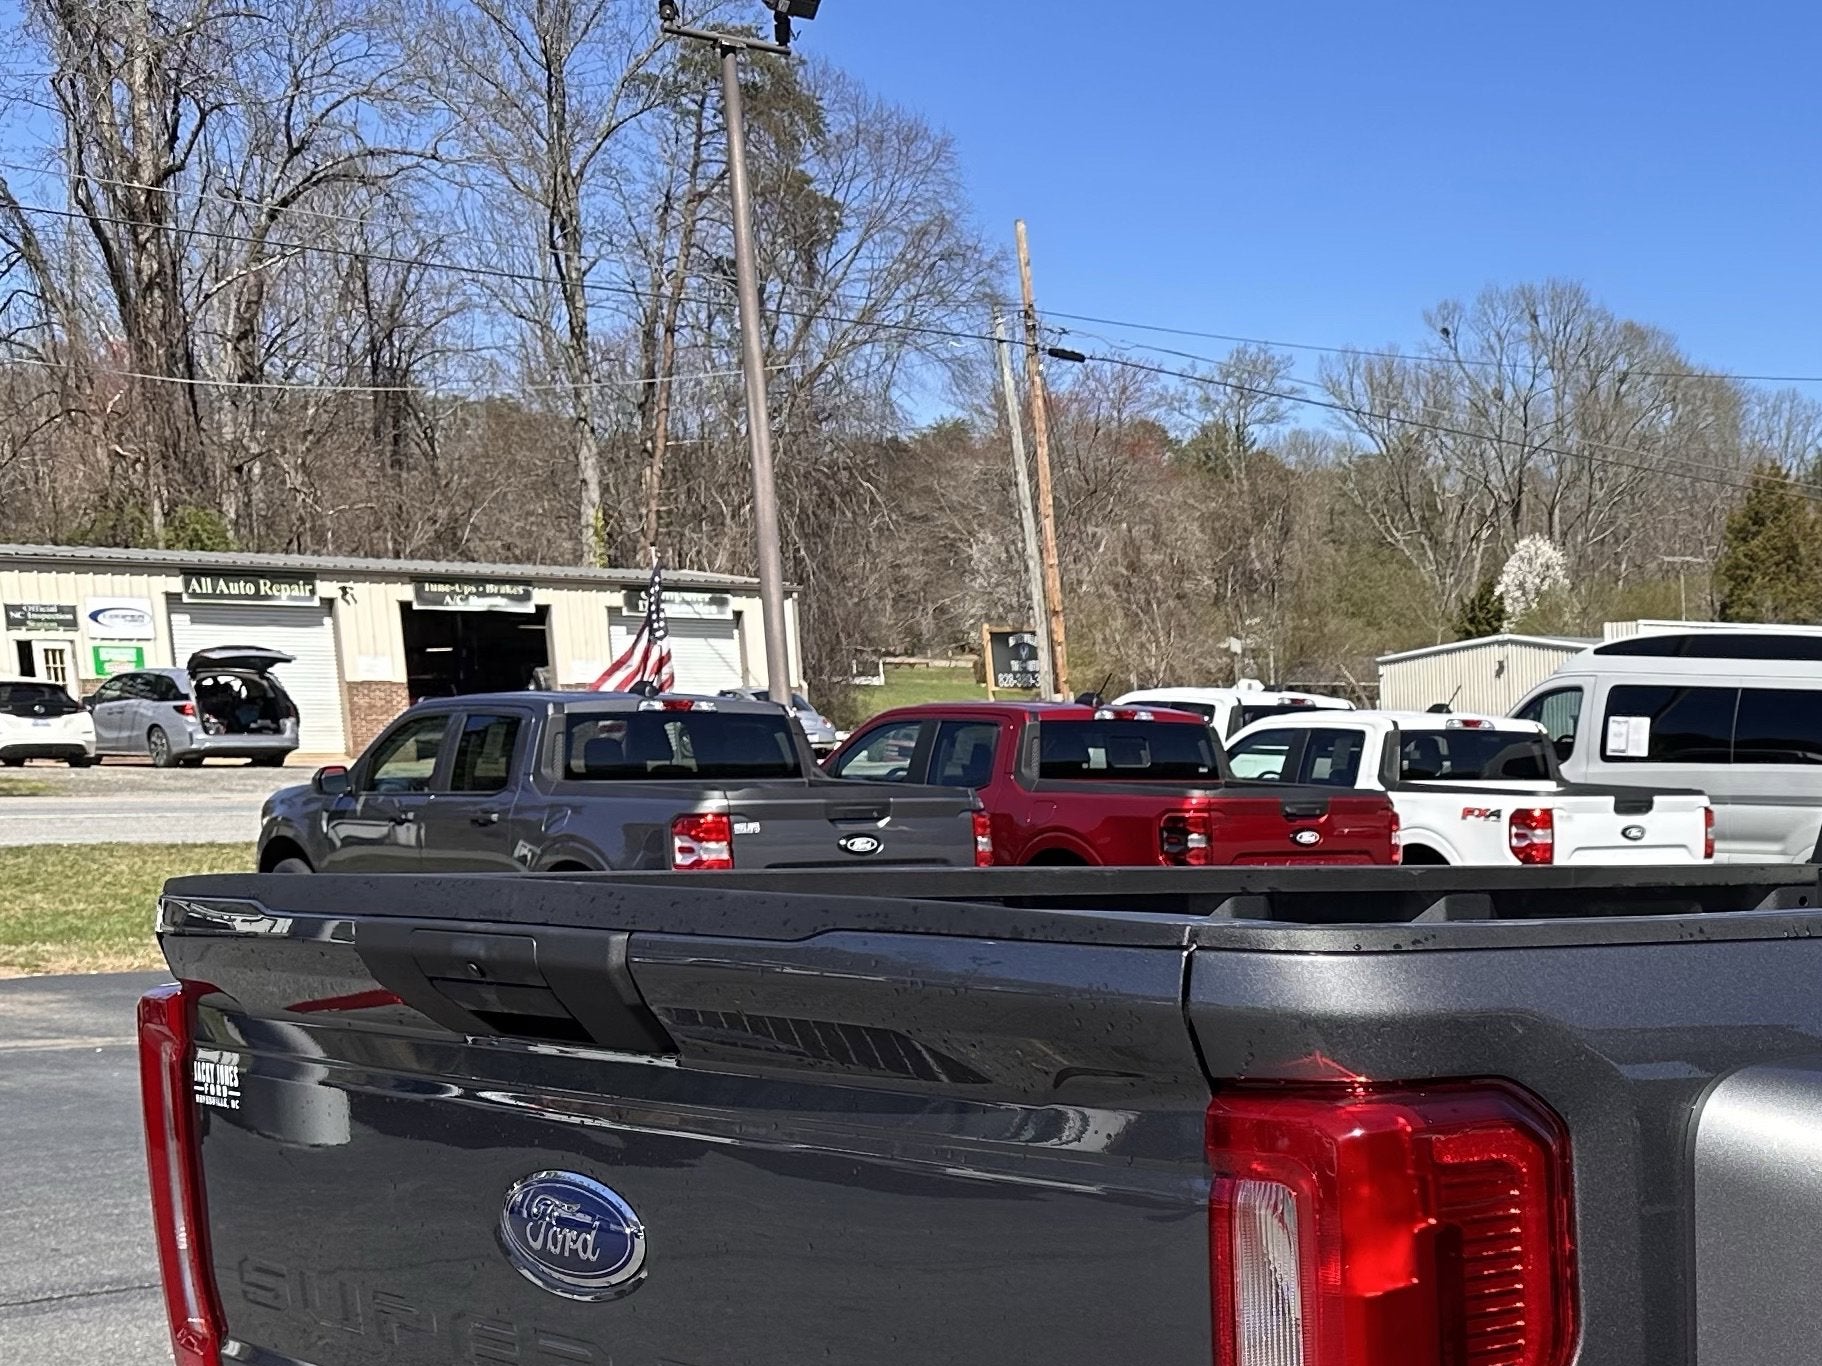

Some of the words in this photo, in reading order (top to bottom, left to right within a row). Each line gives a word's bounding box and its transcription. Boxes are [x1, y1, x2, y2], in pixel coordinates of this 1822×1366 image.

[188, 577, 213, 594] All
[215, 578, 256, 595] Auto
[260, 578, 313, 600] Repair
[215, 1063, 239, 1088] JONES
[204, 1082, 228, 1097] FORD
[525, 1194, 602, 1263] Ford
